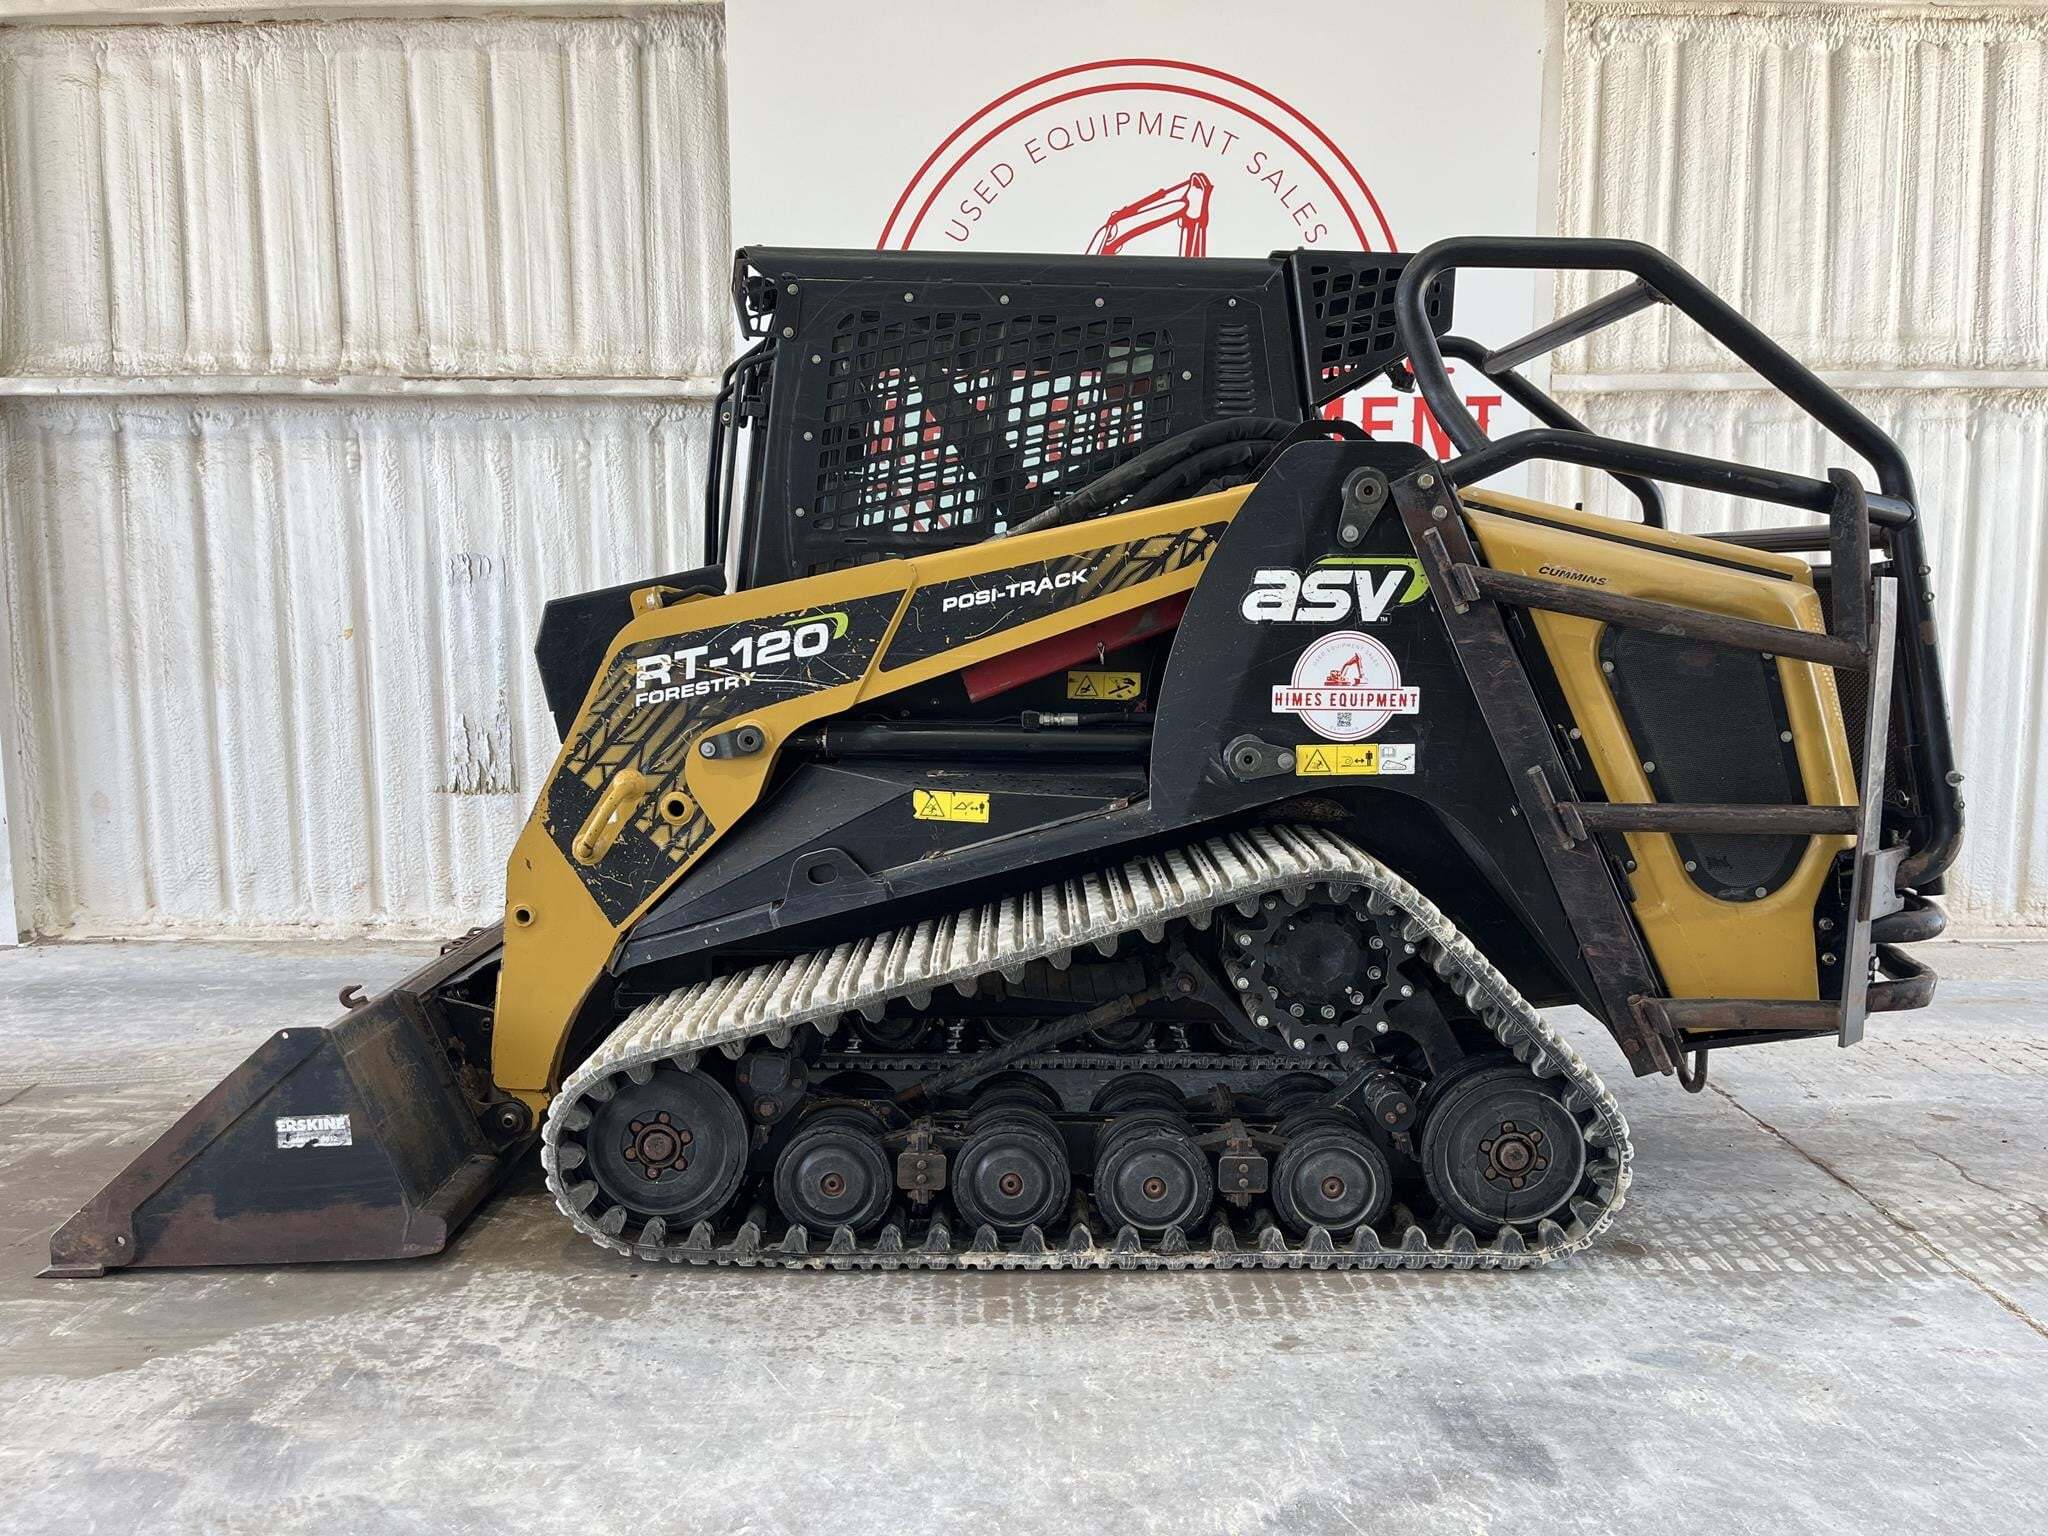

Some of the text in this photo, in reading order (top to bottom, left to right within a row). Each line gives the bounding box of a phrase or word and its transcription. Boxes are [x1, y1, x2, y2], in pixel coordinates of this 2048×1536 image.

[944, 110, 1329, 244] USED EQUIPMENT SALES
[942, 568, 1089, 612] POSI-TRACK
[1538, 566, 1607, 586] CUMMINS
[635, 622, 829, 689] RT-120
[635, 672, 756, 708] FORESTRY
[1274, 692, 1418, 708] HIMES EQUIPMENT
[275, 1117, 346, 1132] ERSKINE
